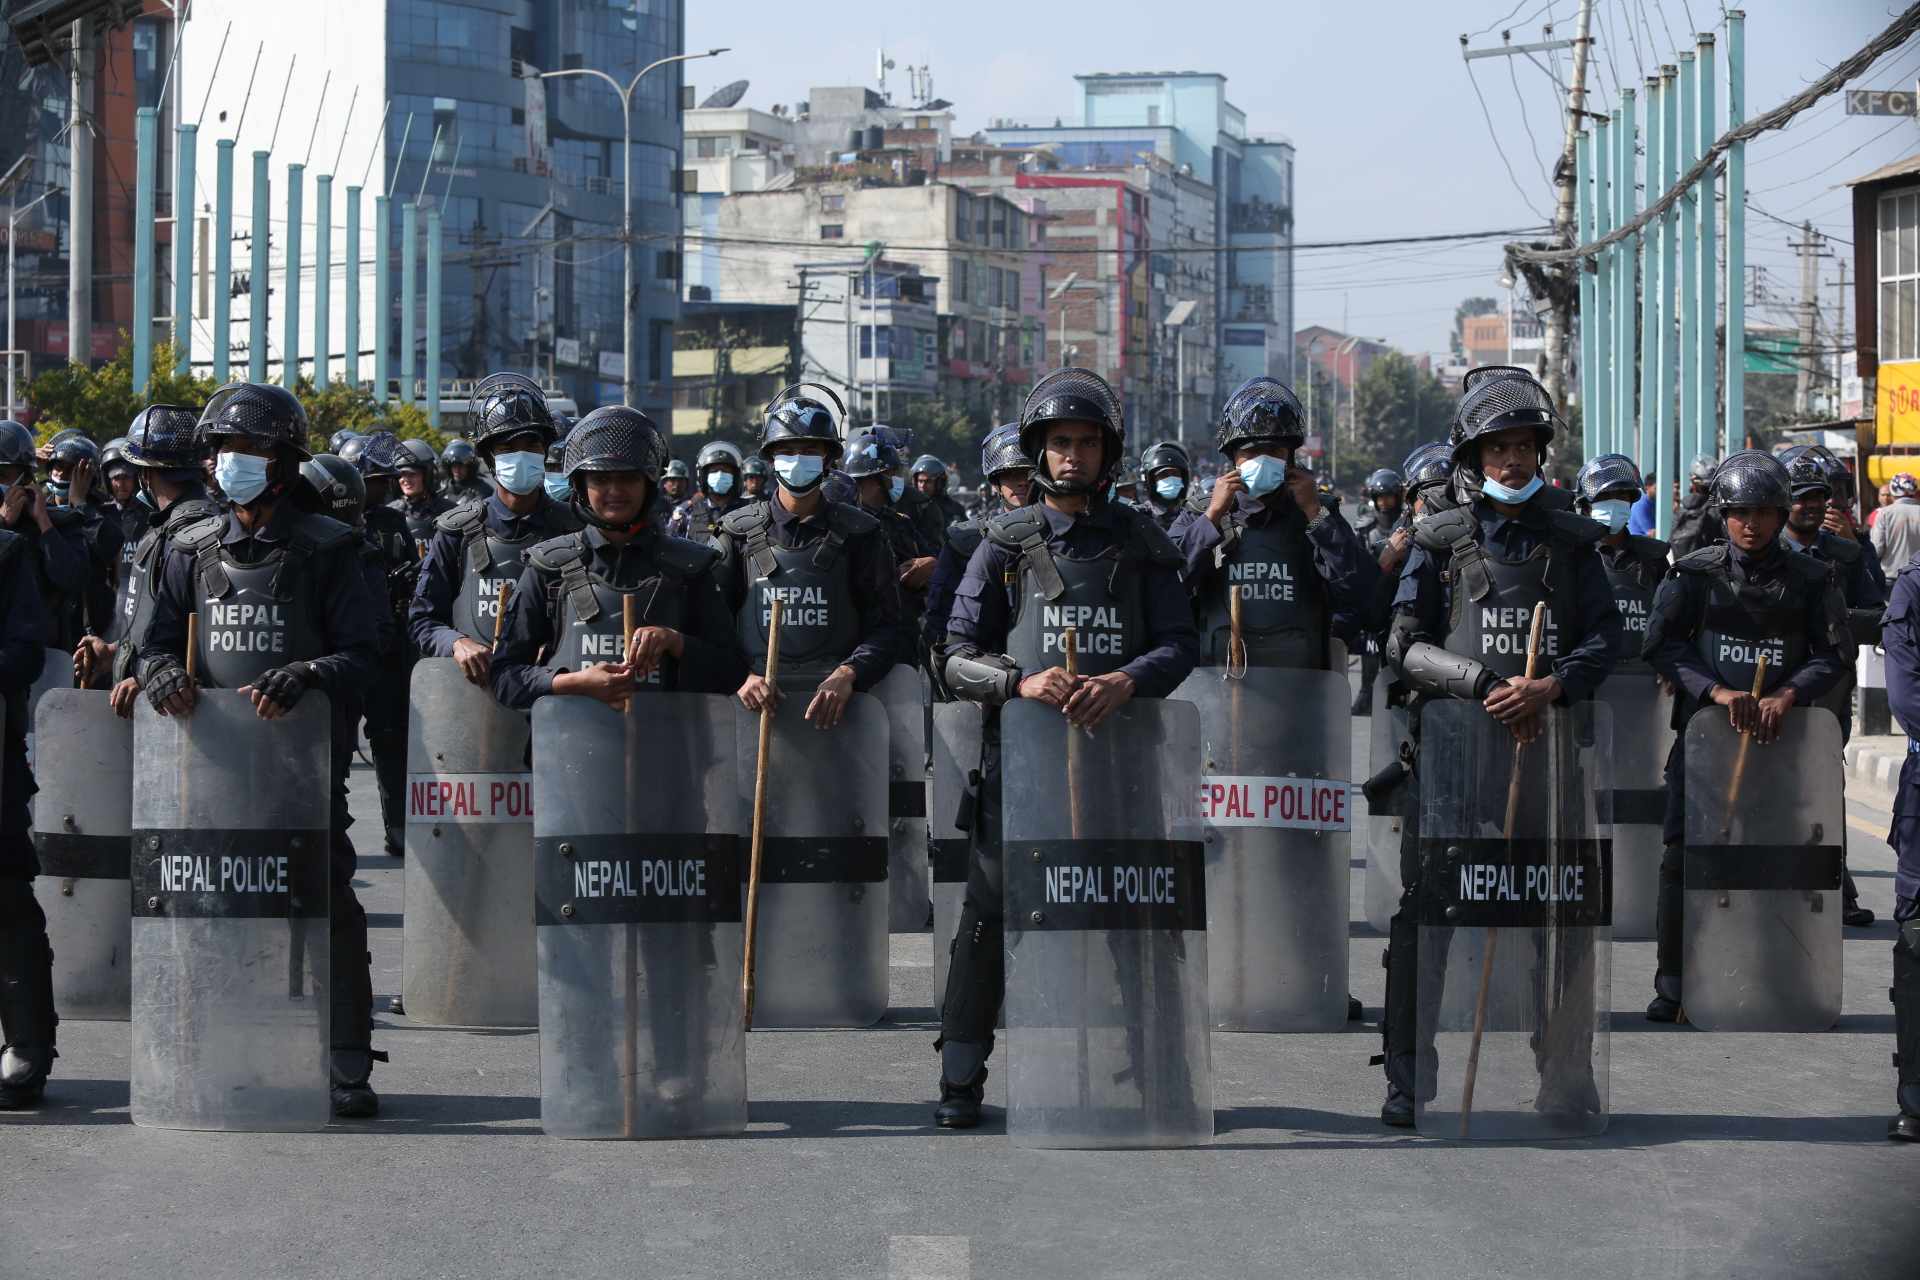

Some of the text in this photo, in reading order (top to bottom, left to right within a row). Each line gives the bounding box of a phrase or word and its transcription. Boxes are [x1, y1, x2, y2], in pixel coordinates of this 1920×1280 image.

[1228, 562, 1294, 581] NEPAL
[762, 587, 828, 605] NEPAL
[1229, 583, 1294, 602] OLICE
[211, 604, 285, 626] NEPAL
[762, 608, 828, 627] PLICE
[1043, 606, 1122, 629] NEPAL
[1615, 599, 1647, 614] PAL
[1482, 607, 1558, 630] NEPL
[210, 631, 285, 653] POLICE
[582, 634, 625, 656] NEP
[411, 781, 534, 817] NEPAL POL
[1200, 784, 1345, 823] EPAL POLICE
[161, 855, 288, 893] NEPAL POLICE
[575, 859, 706, 898] NEPAL POLICE
[1046, 866, 1175, 904] NEPAL POLICE
[1460, 864, 1584, 902] NEPAL POLICE
